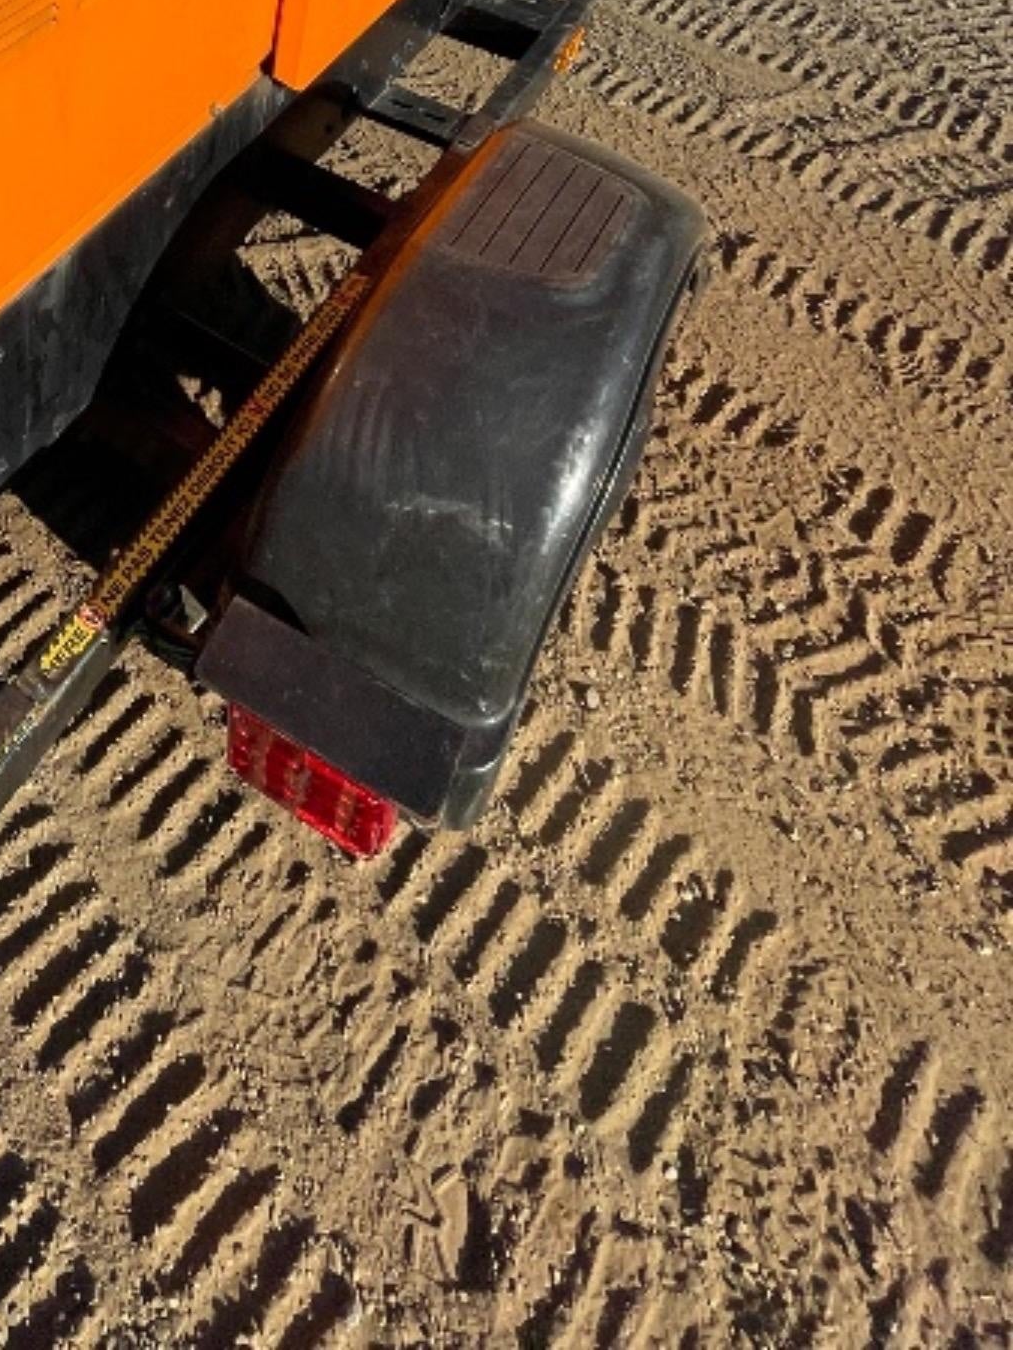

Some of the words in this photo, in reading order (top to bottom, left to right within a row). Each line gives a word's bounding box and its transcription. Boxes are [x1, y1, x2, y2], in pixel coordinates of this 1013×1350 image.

[99, 578, 126, 606] NE
[119, 544, 153, 581] PAS
[147, 495, 192, 546] TENEZ
[185, 435, 241, 498] DEBOUT
